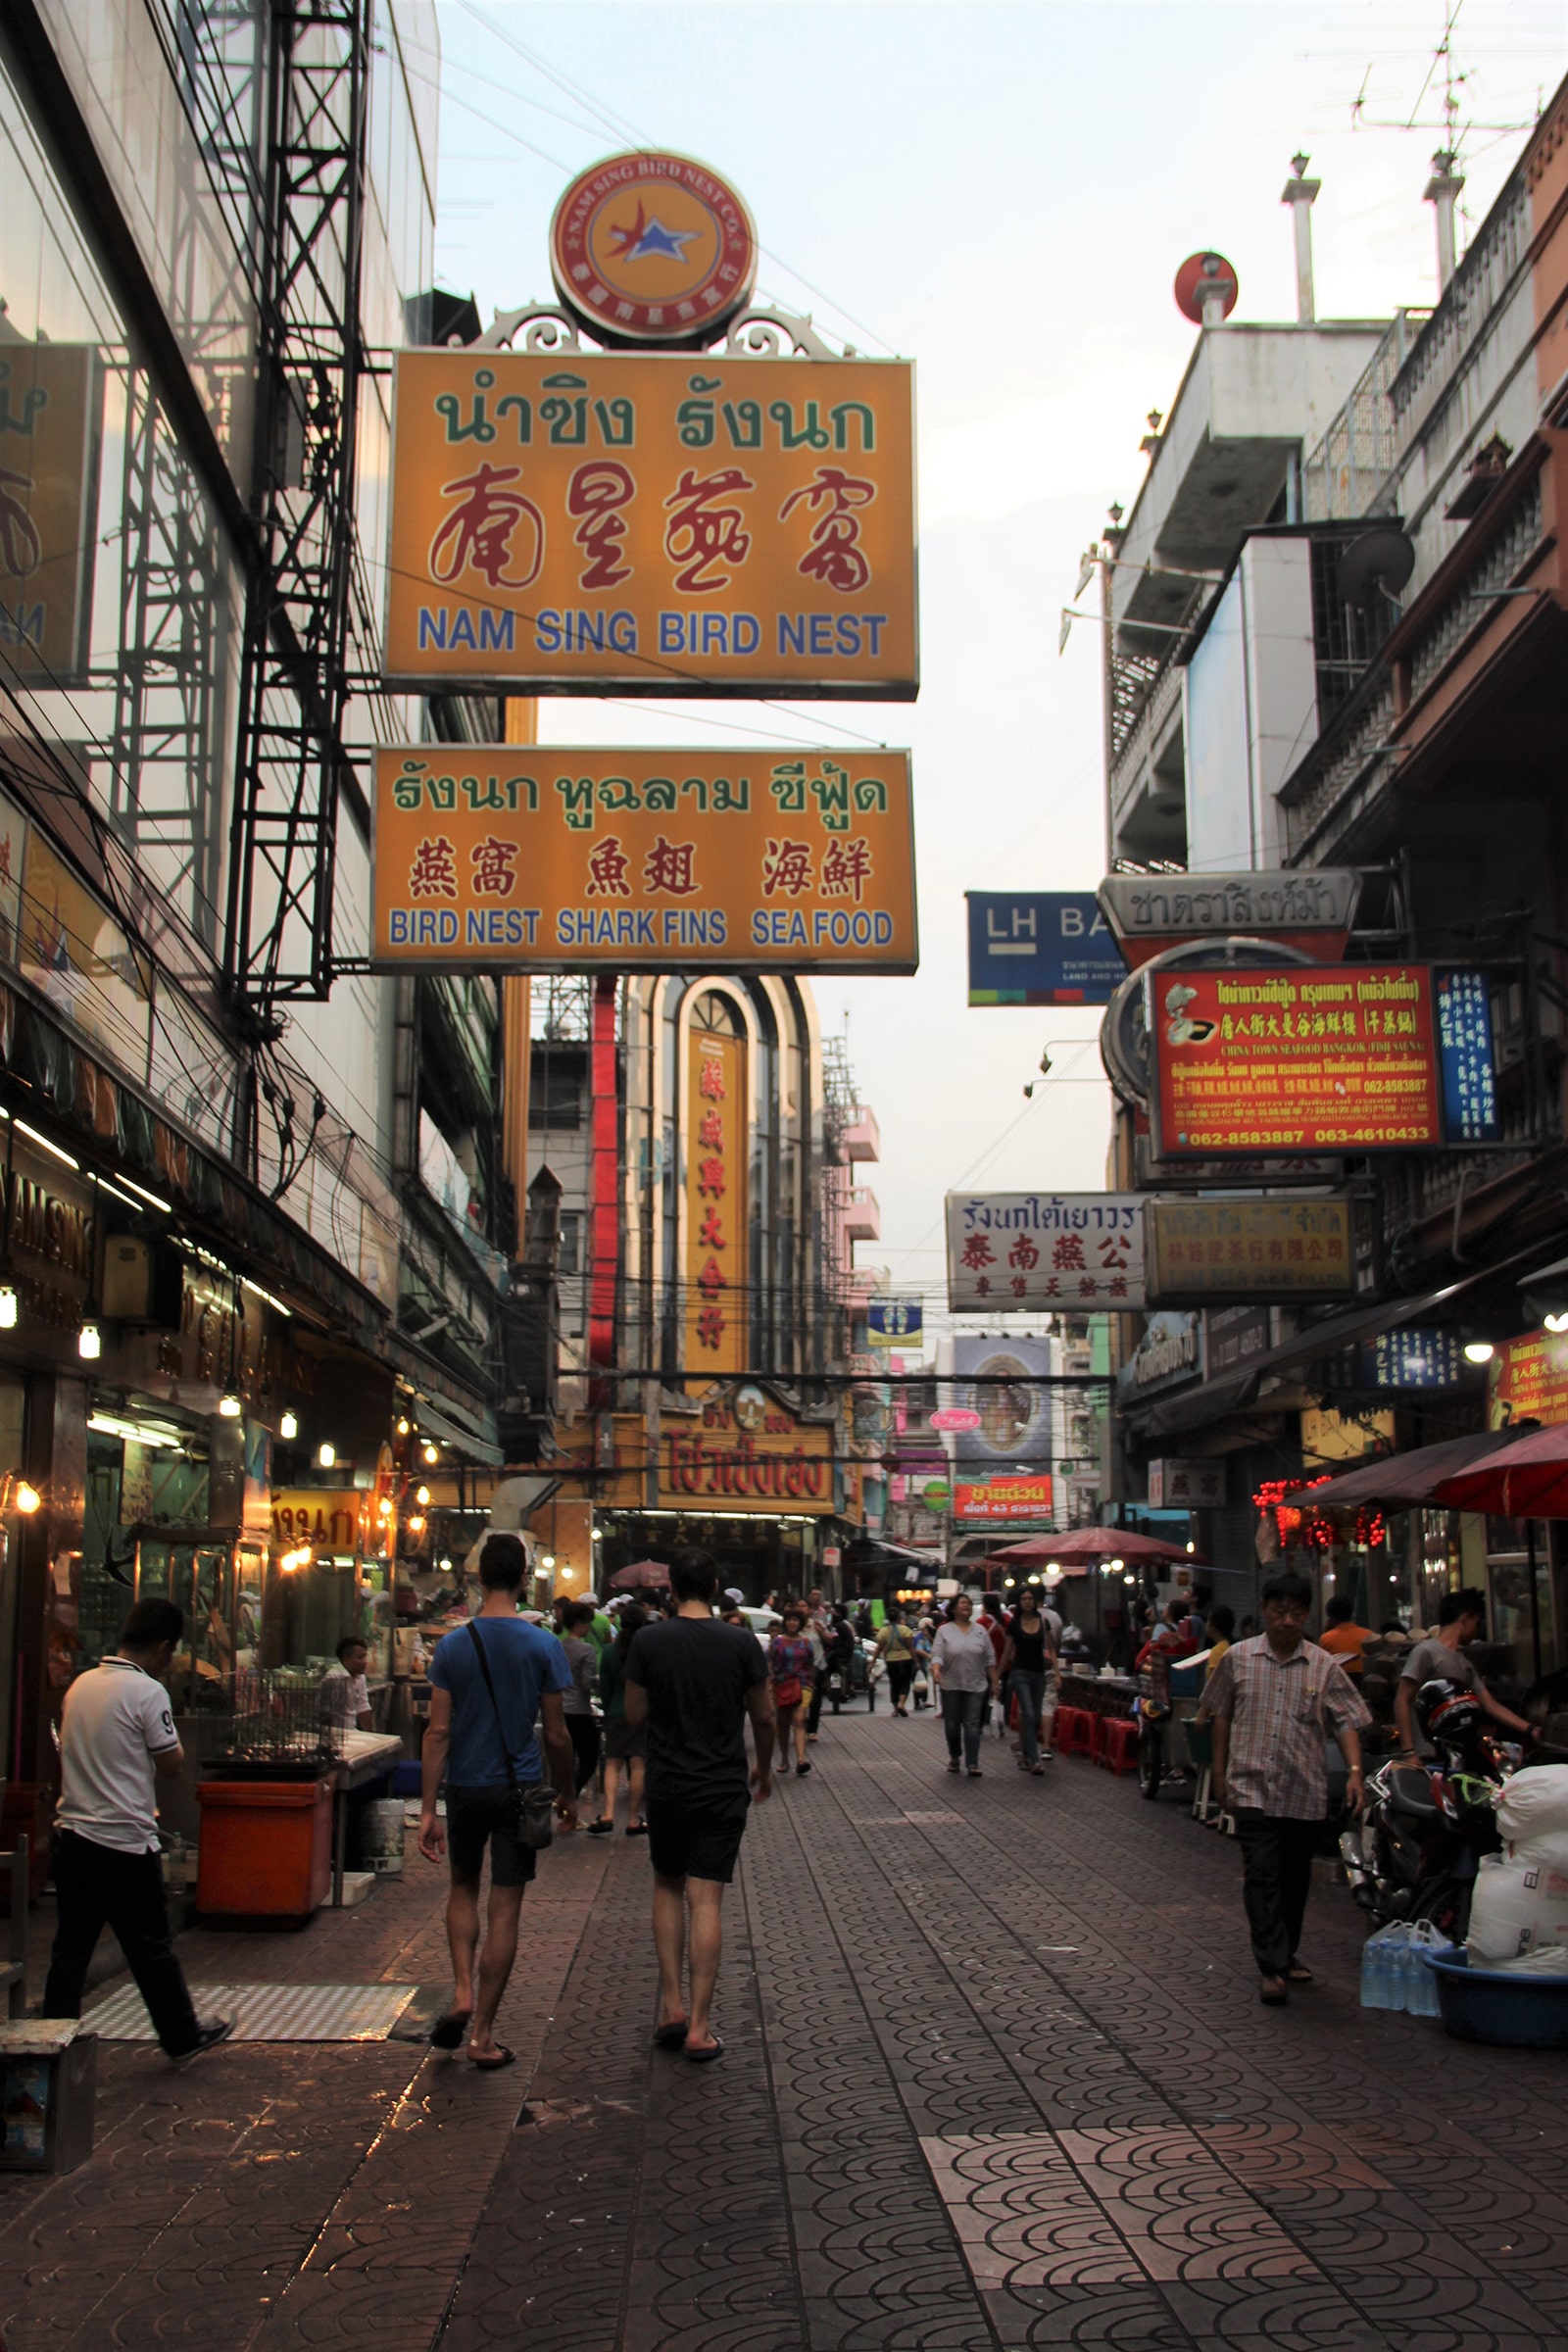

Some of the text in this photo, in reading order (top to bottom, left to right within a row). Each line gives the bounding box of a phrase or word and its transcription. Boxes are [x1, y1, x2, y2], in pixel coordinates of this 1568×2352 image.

[568, 195, 596, 234] NAM
[594, 165, 634, 195] SING
[639, 160, 680, 178] BIRD
[684, 167, 727, 205] NEST
[434, 368, 876, 453] นำซิง รังนก
[417, 608, 888, 658] NAM SING BIRD NEST
[392, 760, 887, 831] รังนก หูฉลาม ซีฟู้ด
[409, 835, 872, 904] 燕窩 魚翅 海鮮
[389, 907, 894, 947] BIRD NEST SHARK FINS SEA FOOD
[987, 907, 1037, 937] LH
[1221, 1045, 1250, 1056] CHINA
[1252, 1044, 1278, 1055] TOWN
[1280, 1043, 1320, 1055] SEAFOOD
[1323, 1042, 1366, 1054] BANGKOK
[1190, 1126, 1429, 1146] 062-8583887 063-4610433
[162, 1709, 173, 1735] 9
